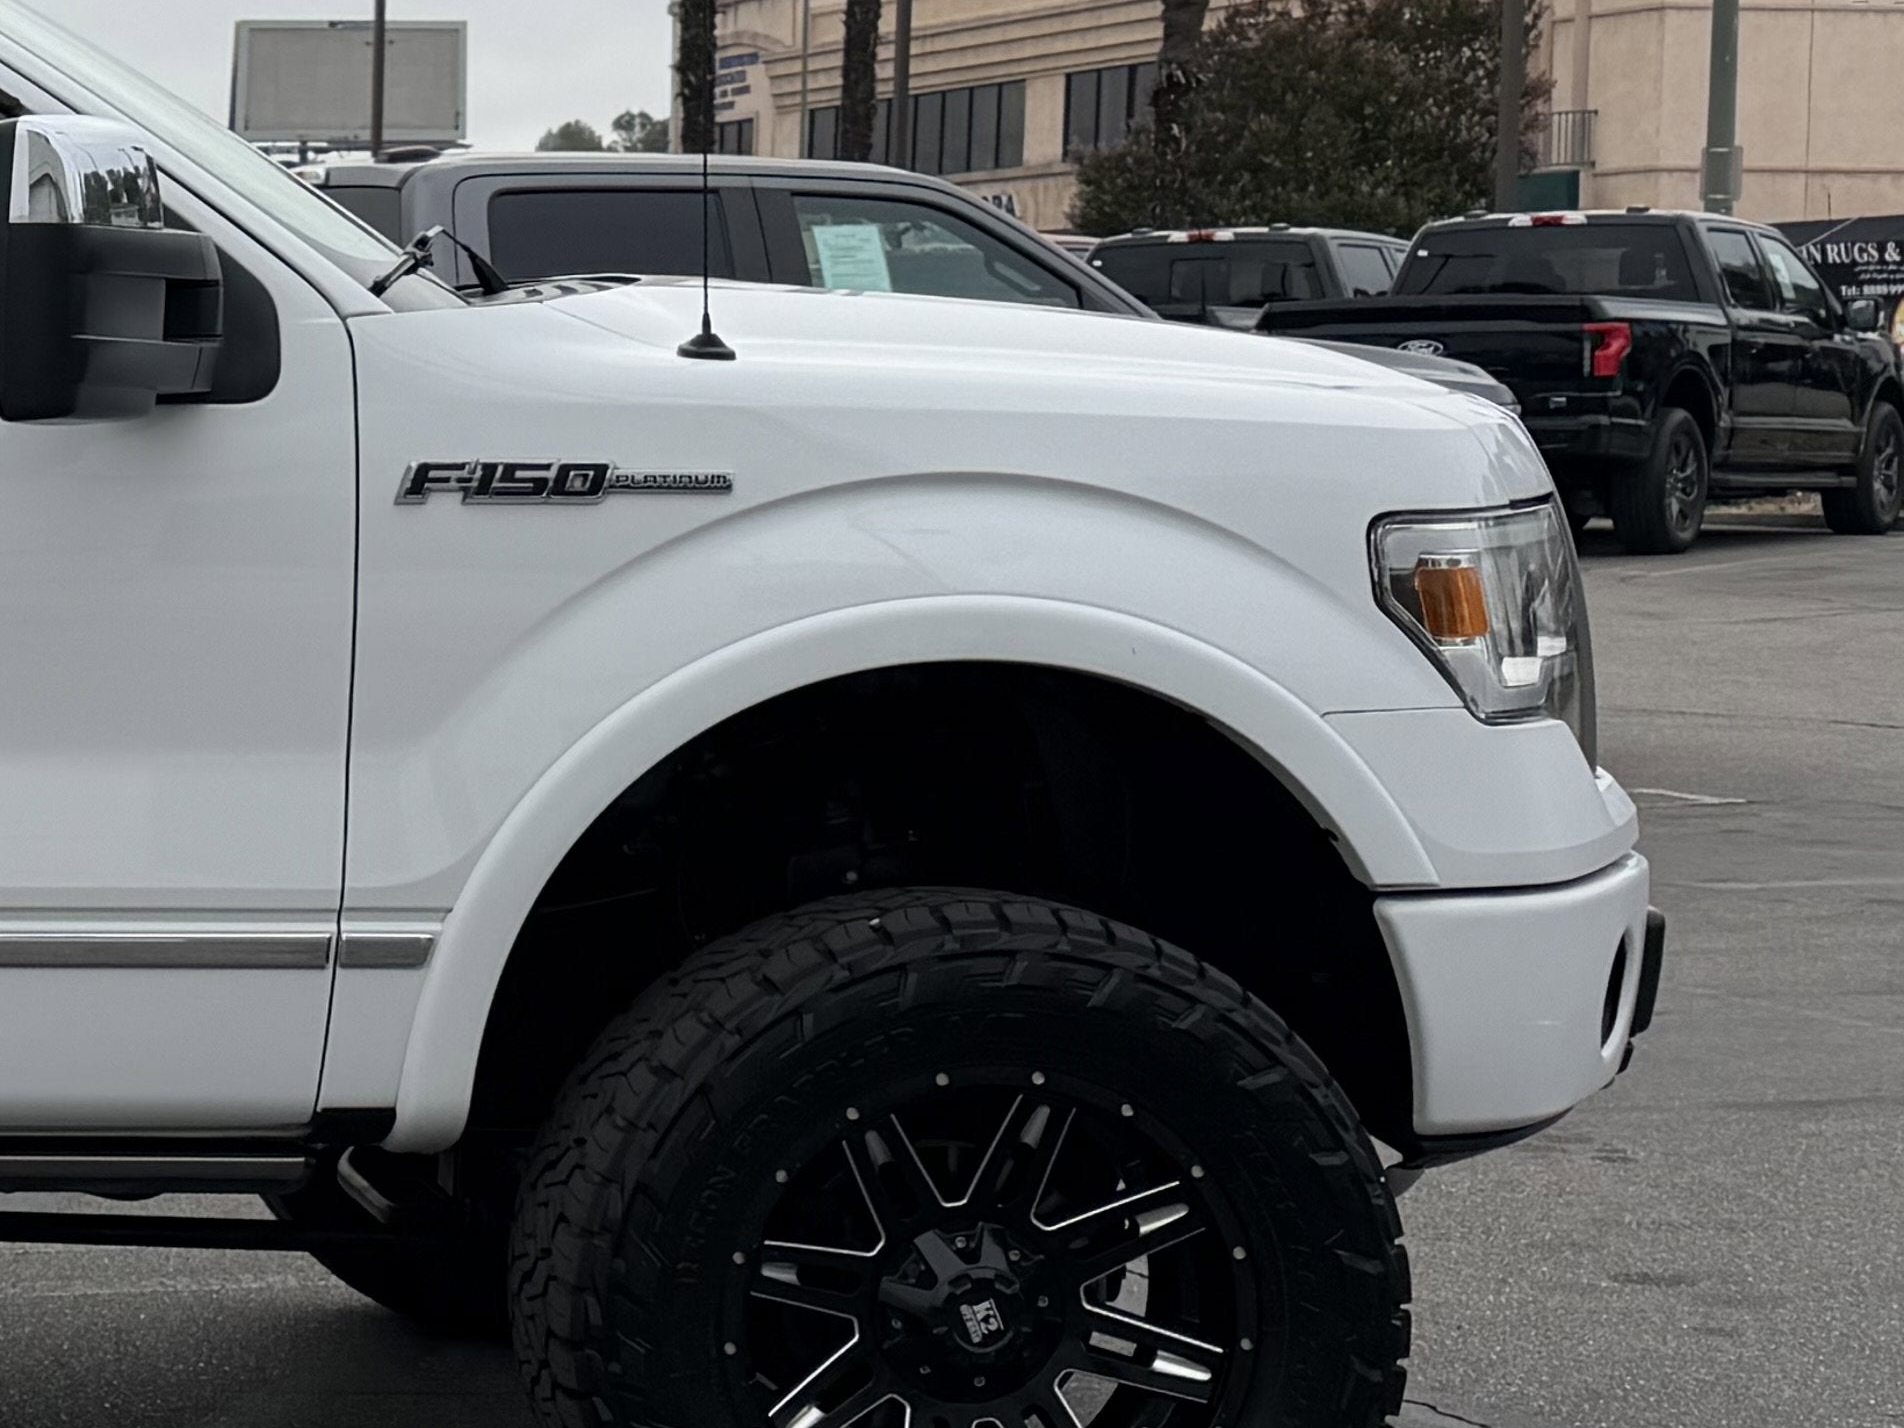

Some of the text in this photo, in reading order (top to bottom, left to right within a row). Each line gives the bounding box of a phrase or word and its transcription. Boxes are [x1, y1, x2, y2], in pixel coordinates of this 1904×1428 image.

[1826, 241, 1879, 264] RUGS
[1884, 241, 1902, 262] &
[398, 459, 731, 504] F-150 PLATINUM
